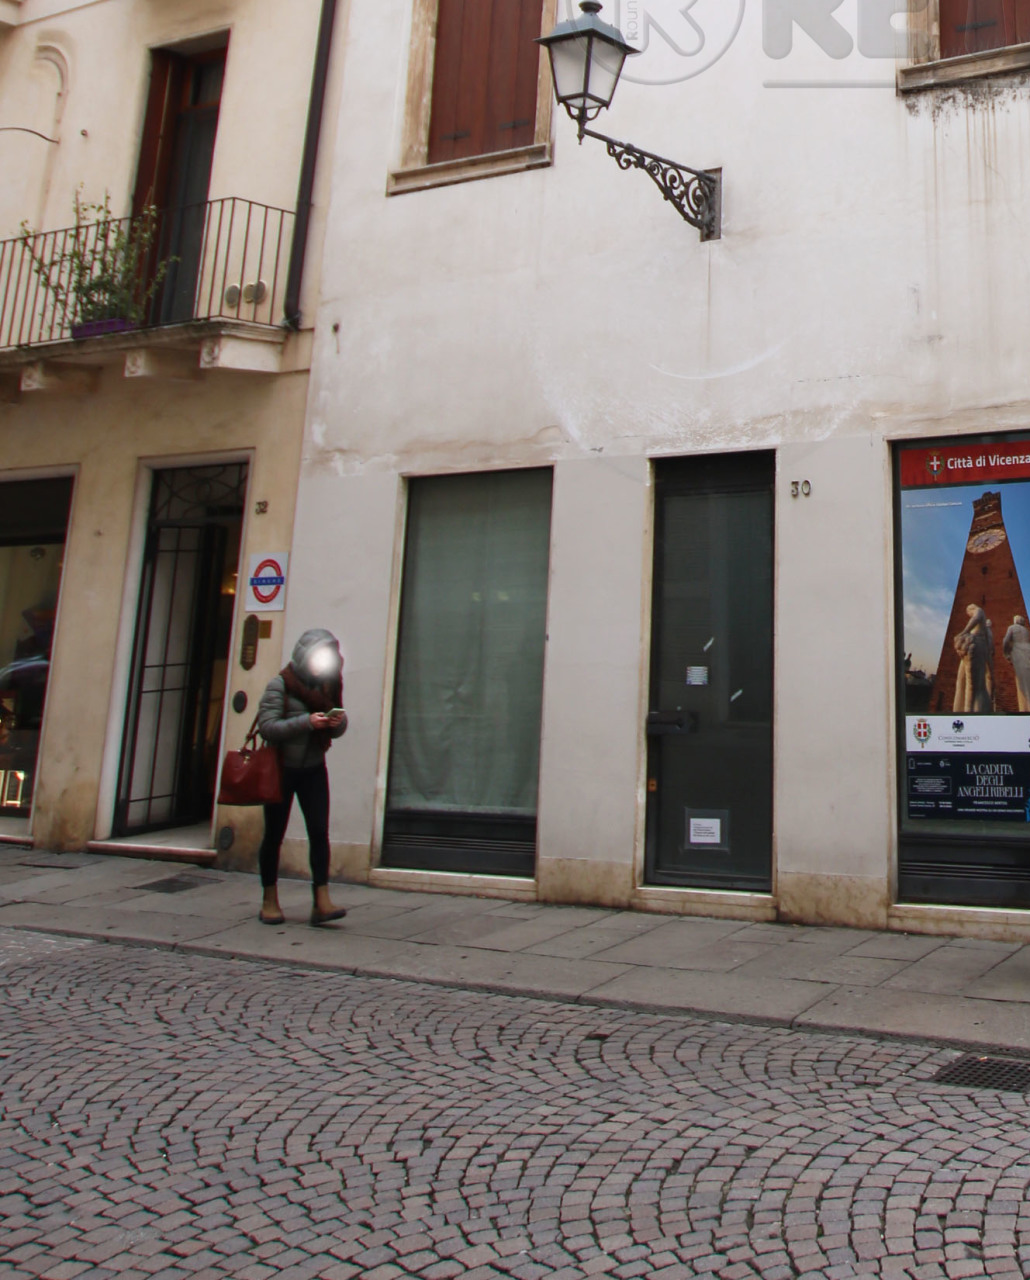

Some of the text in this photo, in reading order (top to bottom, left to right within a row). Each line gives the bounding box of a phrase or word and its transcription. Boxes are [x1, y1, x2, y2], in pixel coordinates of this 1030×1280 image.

[947, 456, 973, 469] Città
[975, 455, 986, 468] di
[791, 479, 811, 498] 30
[966, 763, 1014, 775] LA CADUTA
[976, 775, 1004, 786] DEGLI
[957, 786, 1024, 798] ANGELI RIBELLI
